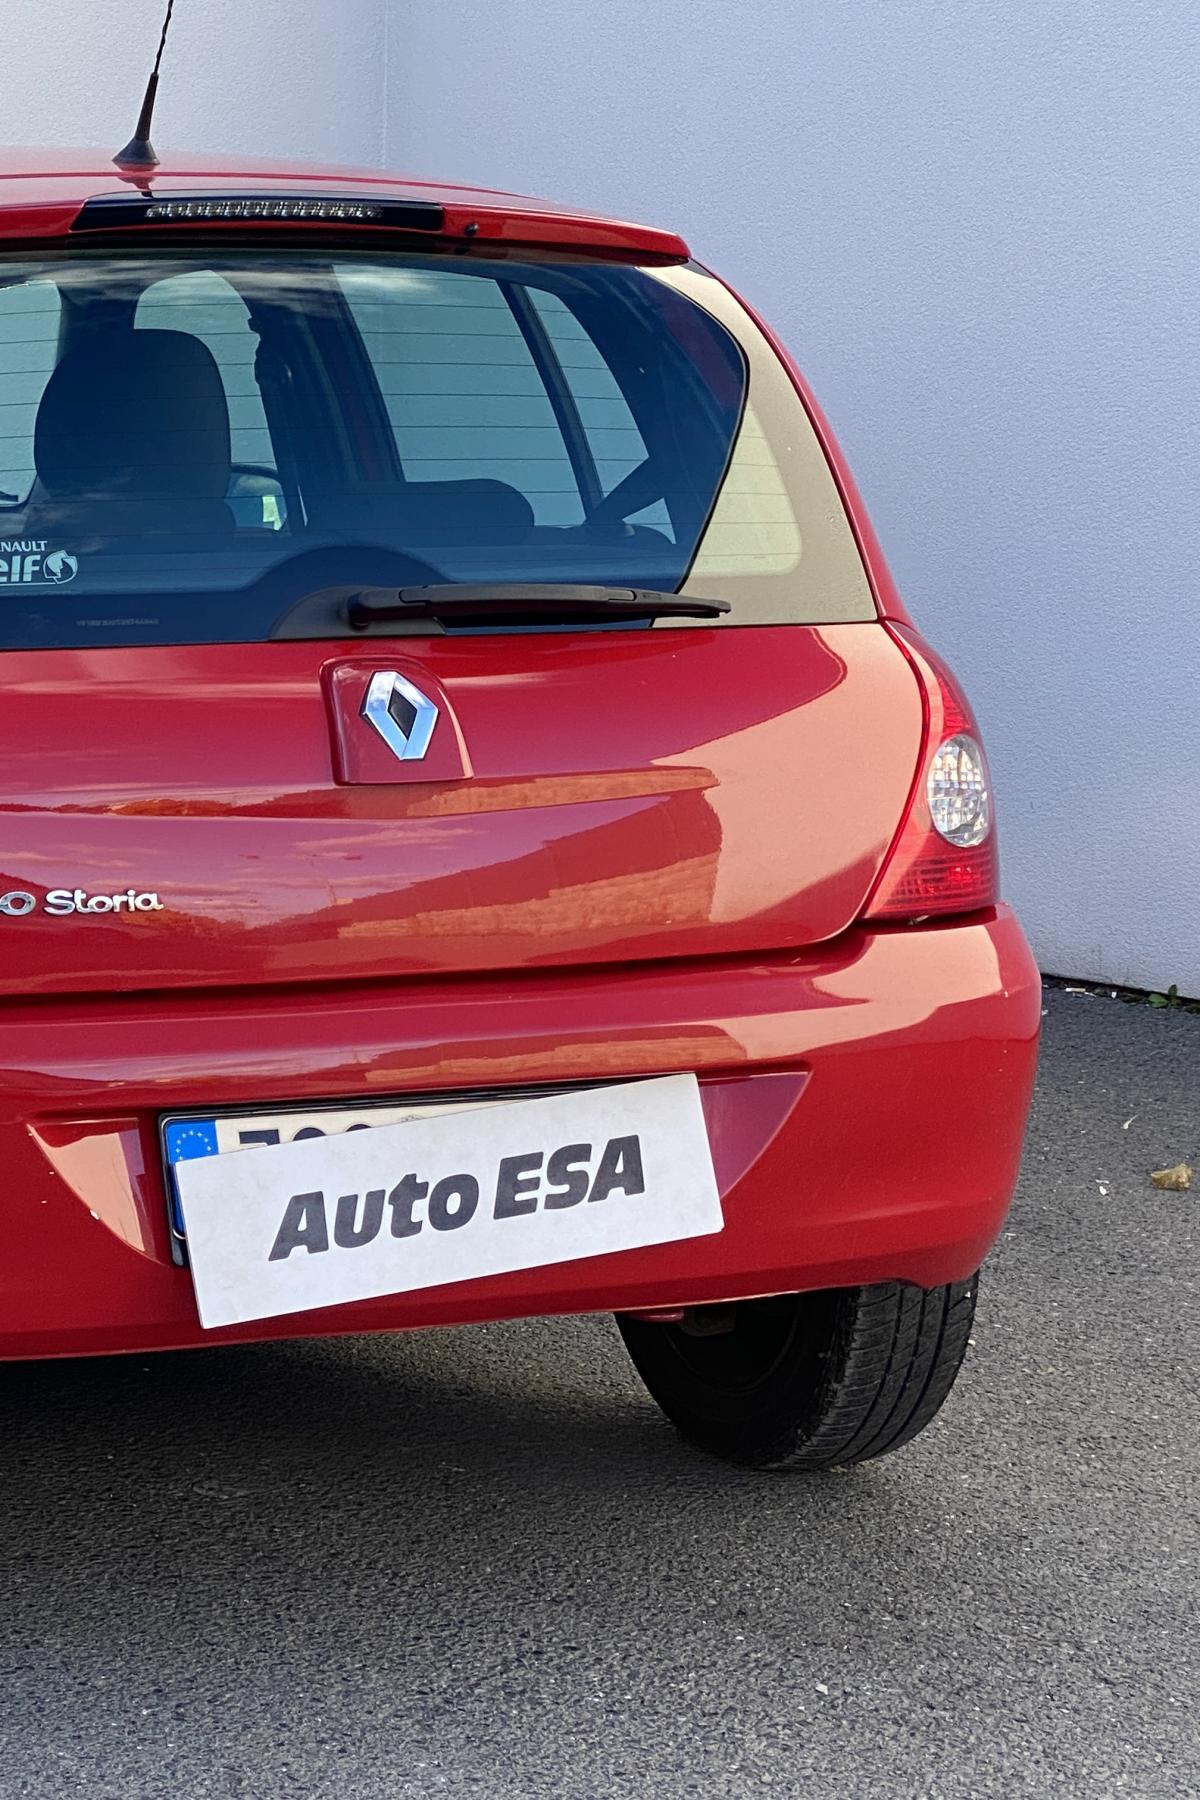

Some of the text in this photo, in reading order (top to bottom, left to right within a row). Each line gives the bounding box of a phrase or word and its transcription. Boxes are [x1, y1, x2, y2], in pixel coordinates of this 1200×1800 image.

[43, 889, 164, 916] Storia
[268, 1134, 645, 1261] Auto ESA
